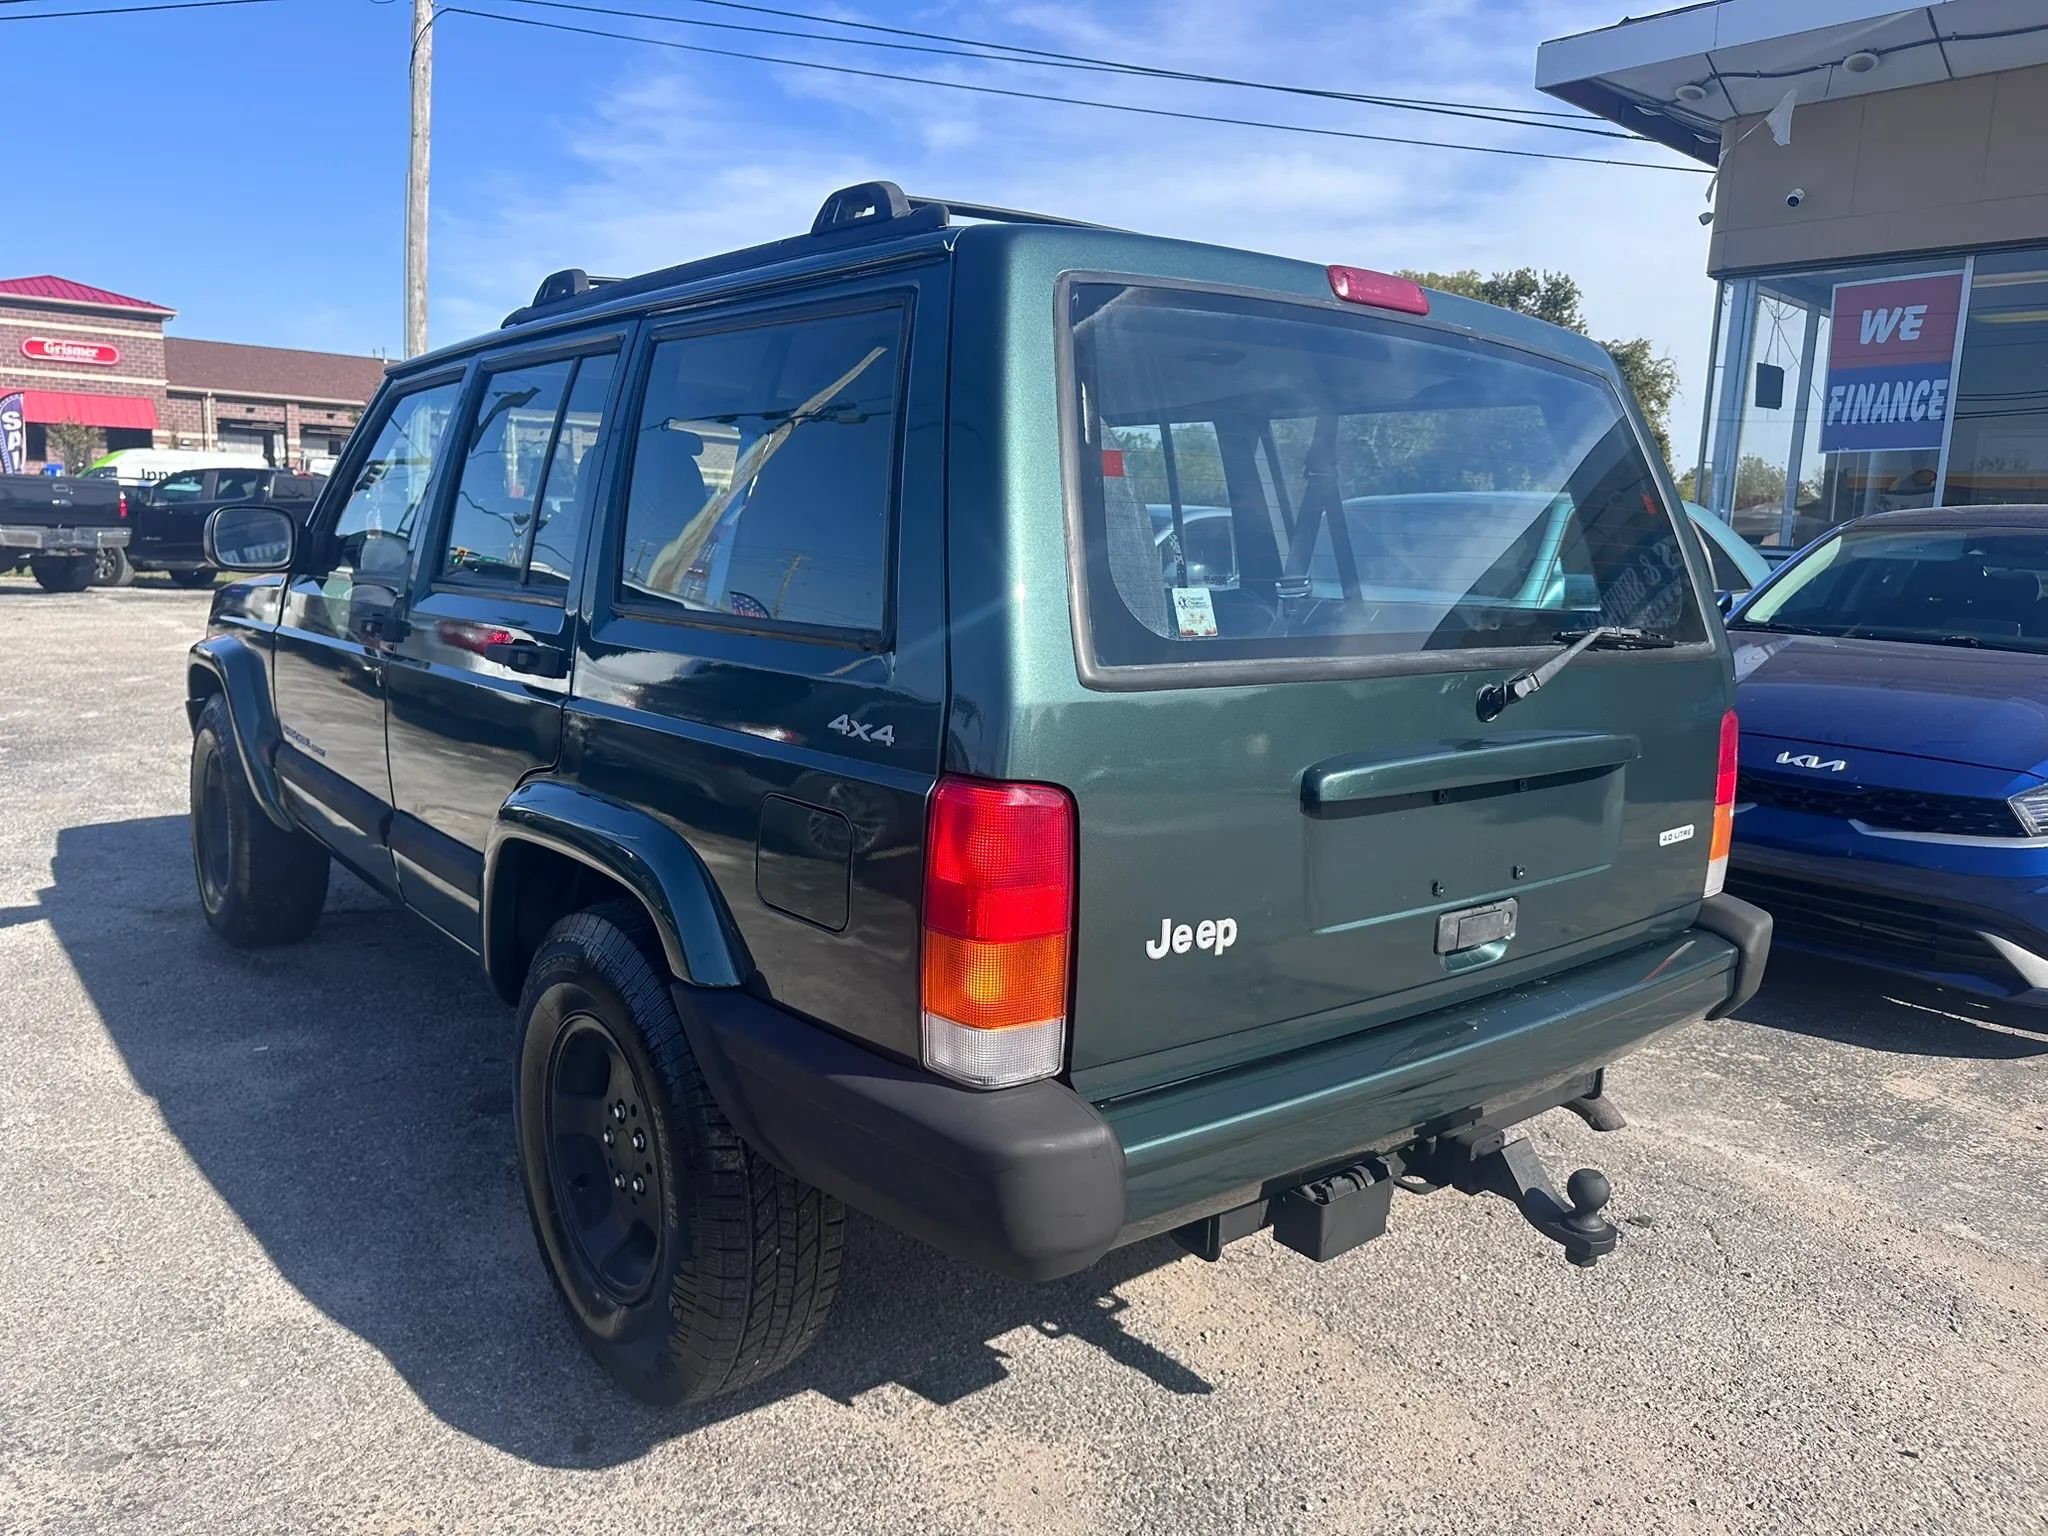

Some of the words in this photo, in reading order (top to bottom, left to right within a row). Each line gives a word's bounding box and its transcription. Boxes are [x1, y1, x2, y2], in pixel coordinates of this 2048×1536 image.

[1860, 305, 1928, 345] WE
[43, 342, 98, 358] Grismer
[1827, 379, 1949, 426] FINANCE
[1674, 828, 1692, 839] LITRE
[1145, 918, 1238, 960] Jeep
